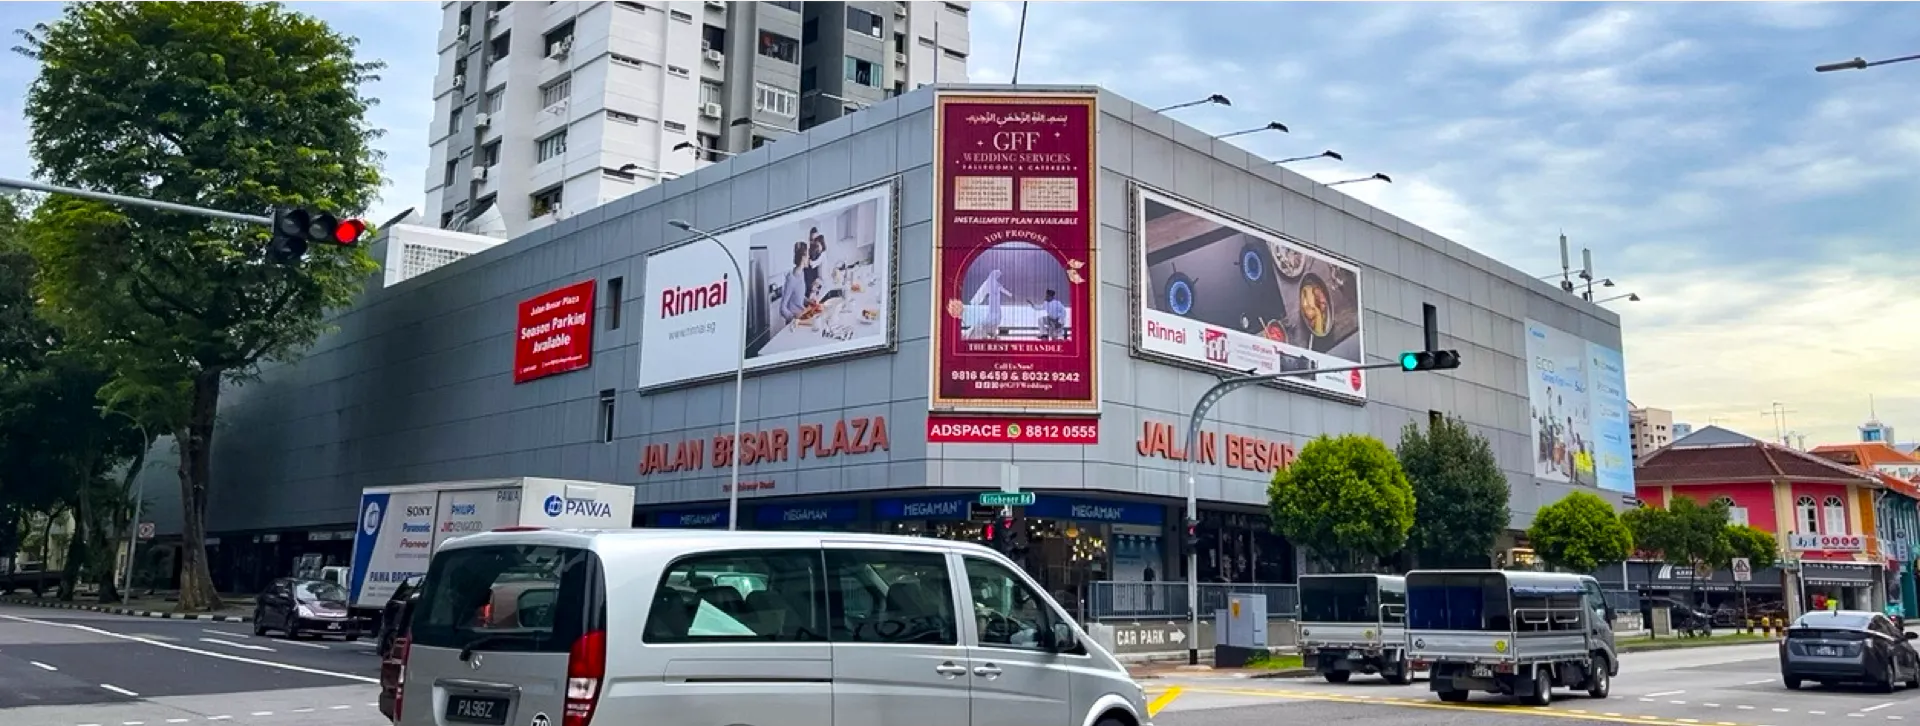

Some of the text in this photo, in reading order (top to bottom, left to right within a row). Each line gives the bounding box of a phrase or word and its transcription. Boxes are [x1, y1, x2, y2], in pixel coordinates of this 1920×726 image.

[993, 131, 1040, 151] GFF
[962, 152, 1071, 163] WEDDING SERVICES
[953, 215, 1079, 225] INSTALLMENT PLAN AVAILABLE
[984, 229, 1048, 243] YOU PROPOSE
[661, 272, 729, 319] Rinnai
[521, 312, 587, 340] Season Parking
[1147, 320, 1187, 345] Rinnai
[532, 332, 572, 354] Available
[968, 343, 1062, 352] THE BEST WE HANDLE
[951, 370, 1080, 382] 9816 6459 & 8032 9242
[930, 424, 1097, 439] ADSPACE 8812 0555
[638, 415, 890, 476] JALAN BESAR PLAZA
[496, 490, 520, 502] PAWA
[982, 494, 1031, 504] Kitchener Rd
[406, 505, 433, 517] SONY
[451, 504, 476, 515] PHILIPS
[565, 499, 612, 517] PAWA
[402, 522, 431, 533] Panasonic
[399, 538, 430, 549] Pioneer
[370, 571, 390, 582] PAWA
[1117, 629, 1165, 646] CAR PARK
